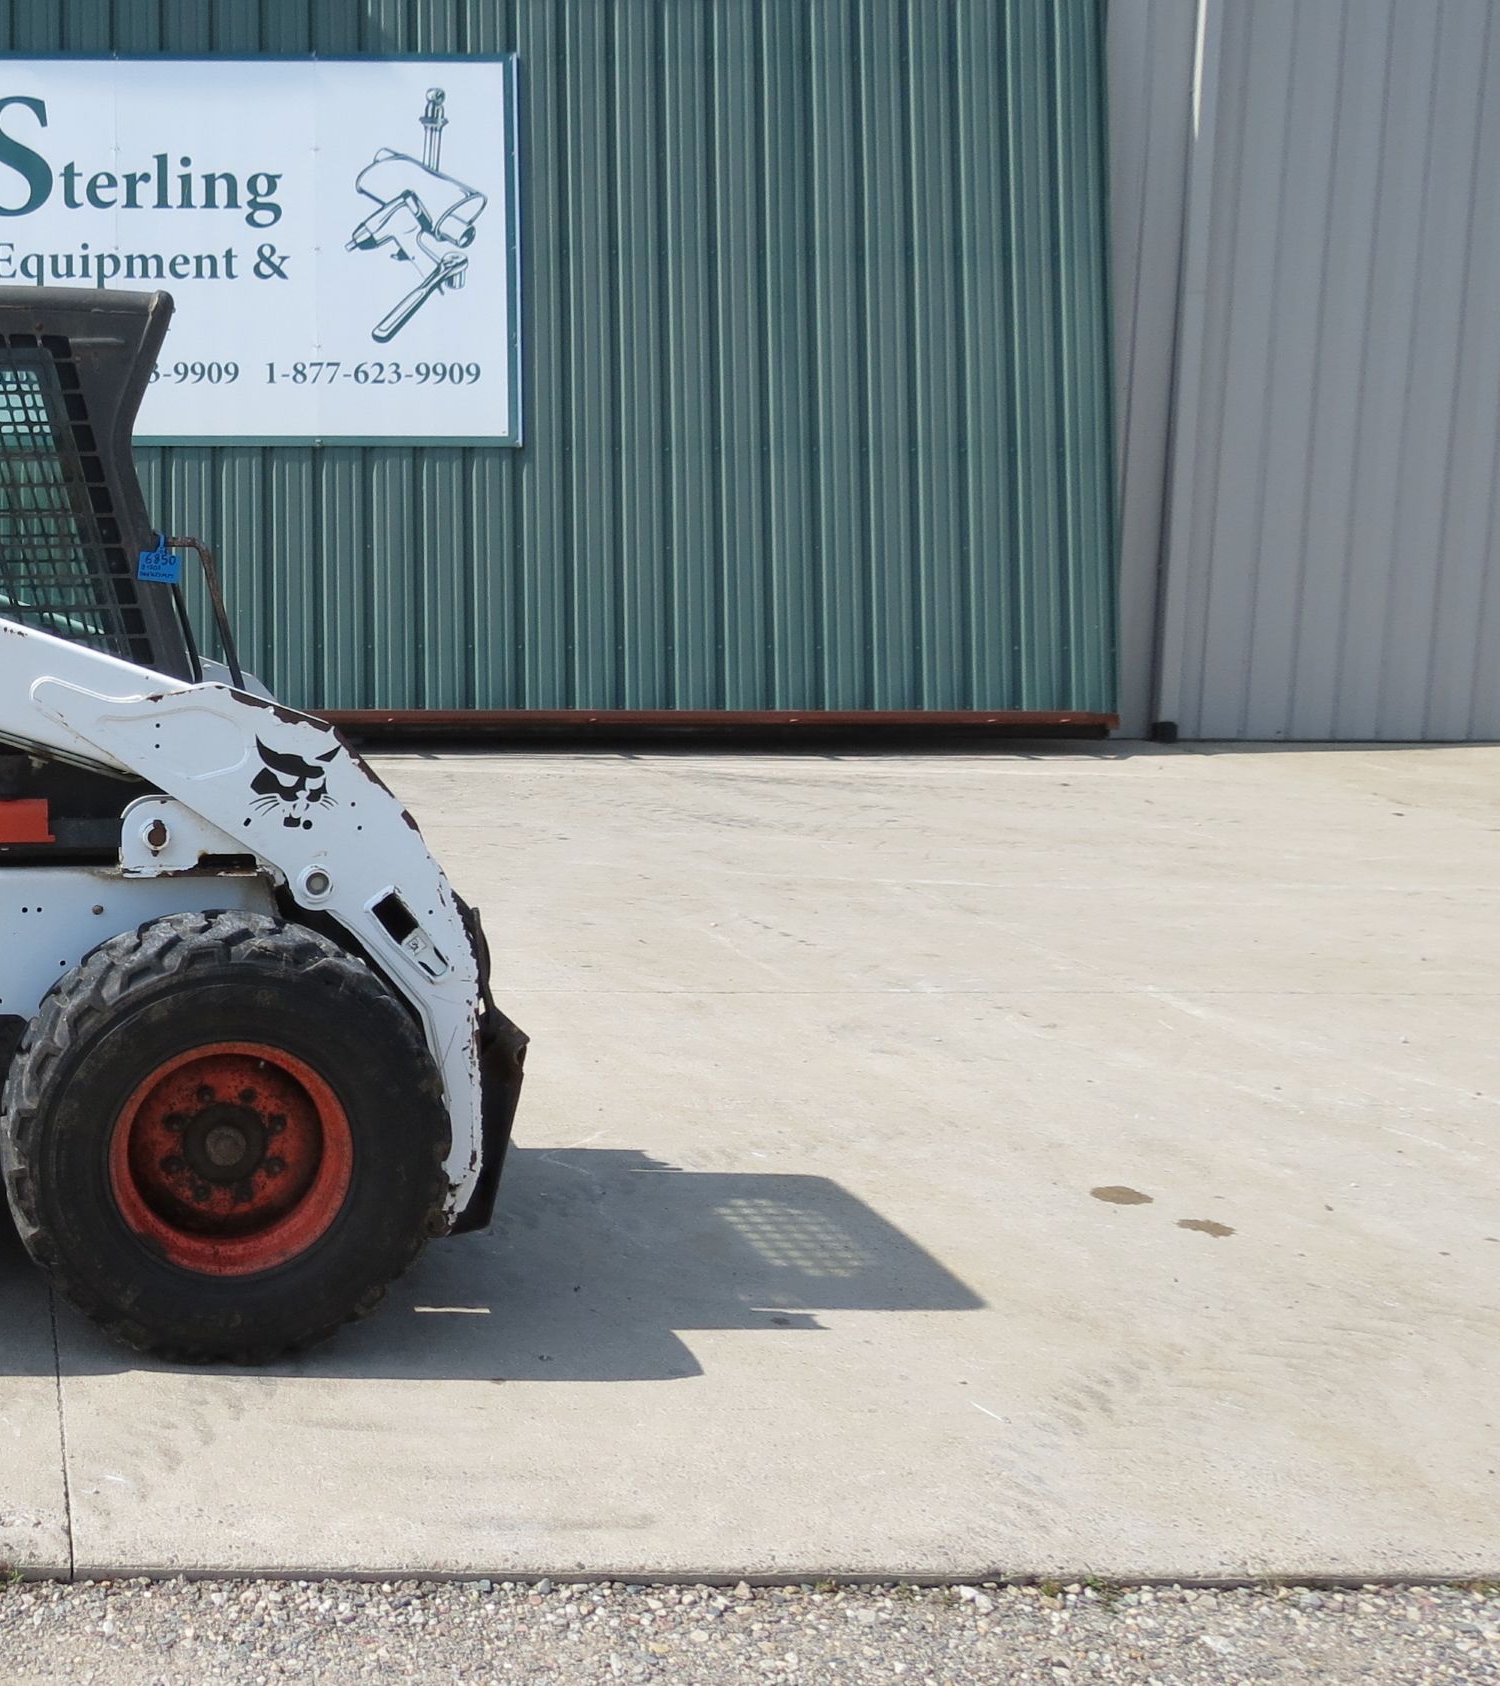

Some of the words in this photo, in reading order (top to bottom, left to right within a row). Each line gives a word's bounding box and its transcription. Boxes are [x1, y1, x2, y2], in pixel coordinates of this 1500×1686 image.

[252, 242, 291, 280] &
[265, 360, 482, 386] 1-877-623-9909
[145, 553, 177, 566] 6850
